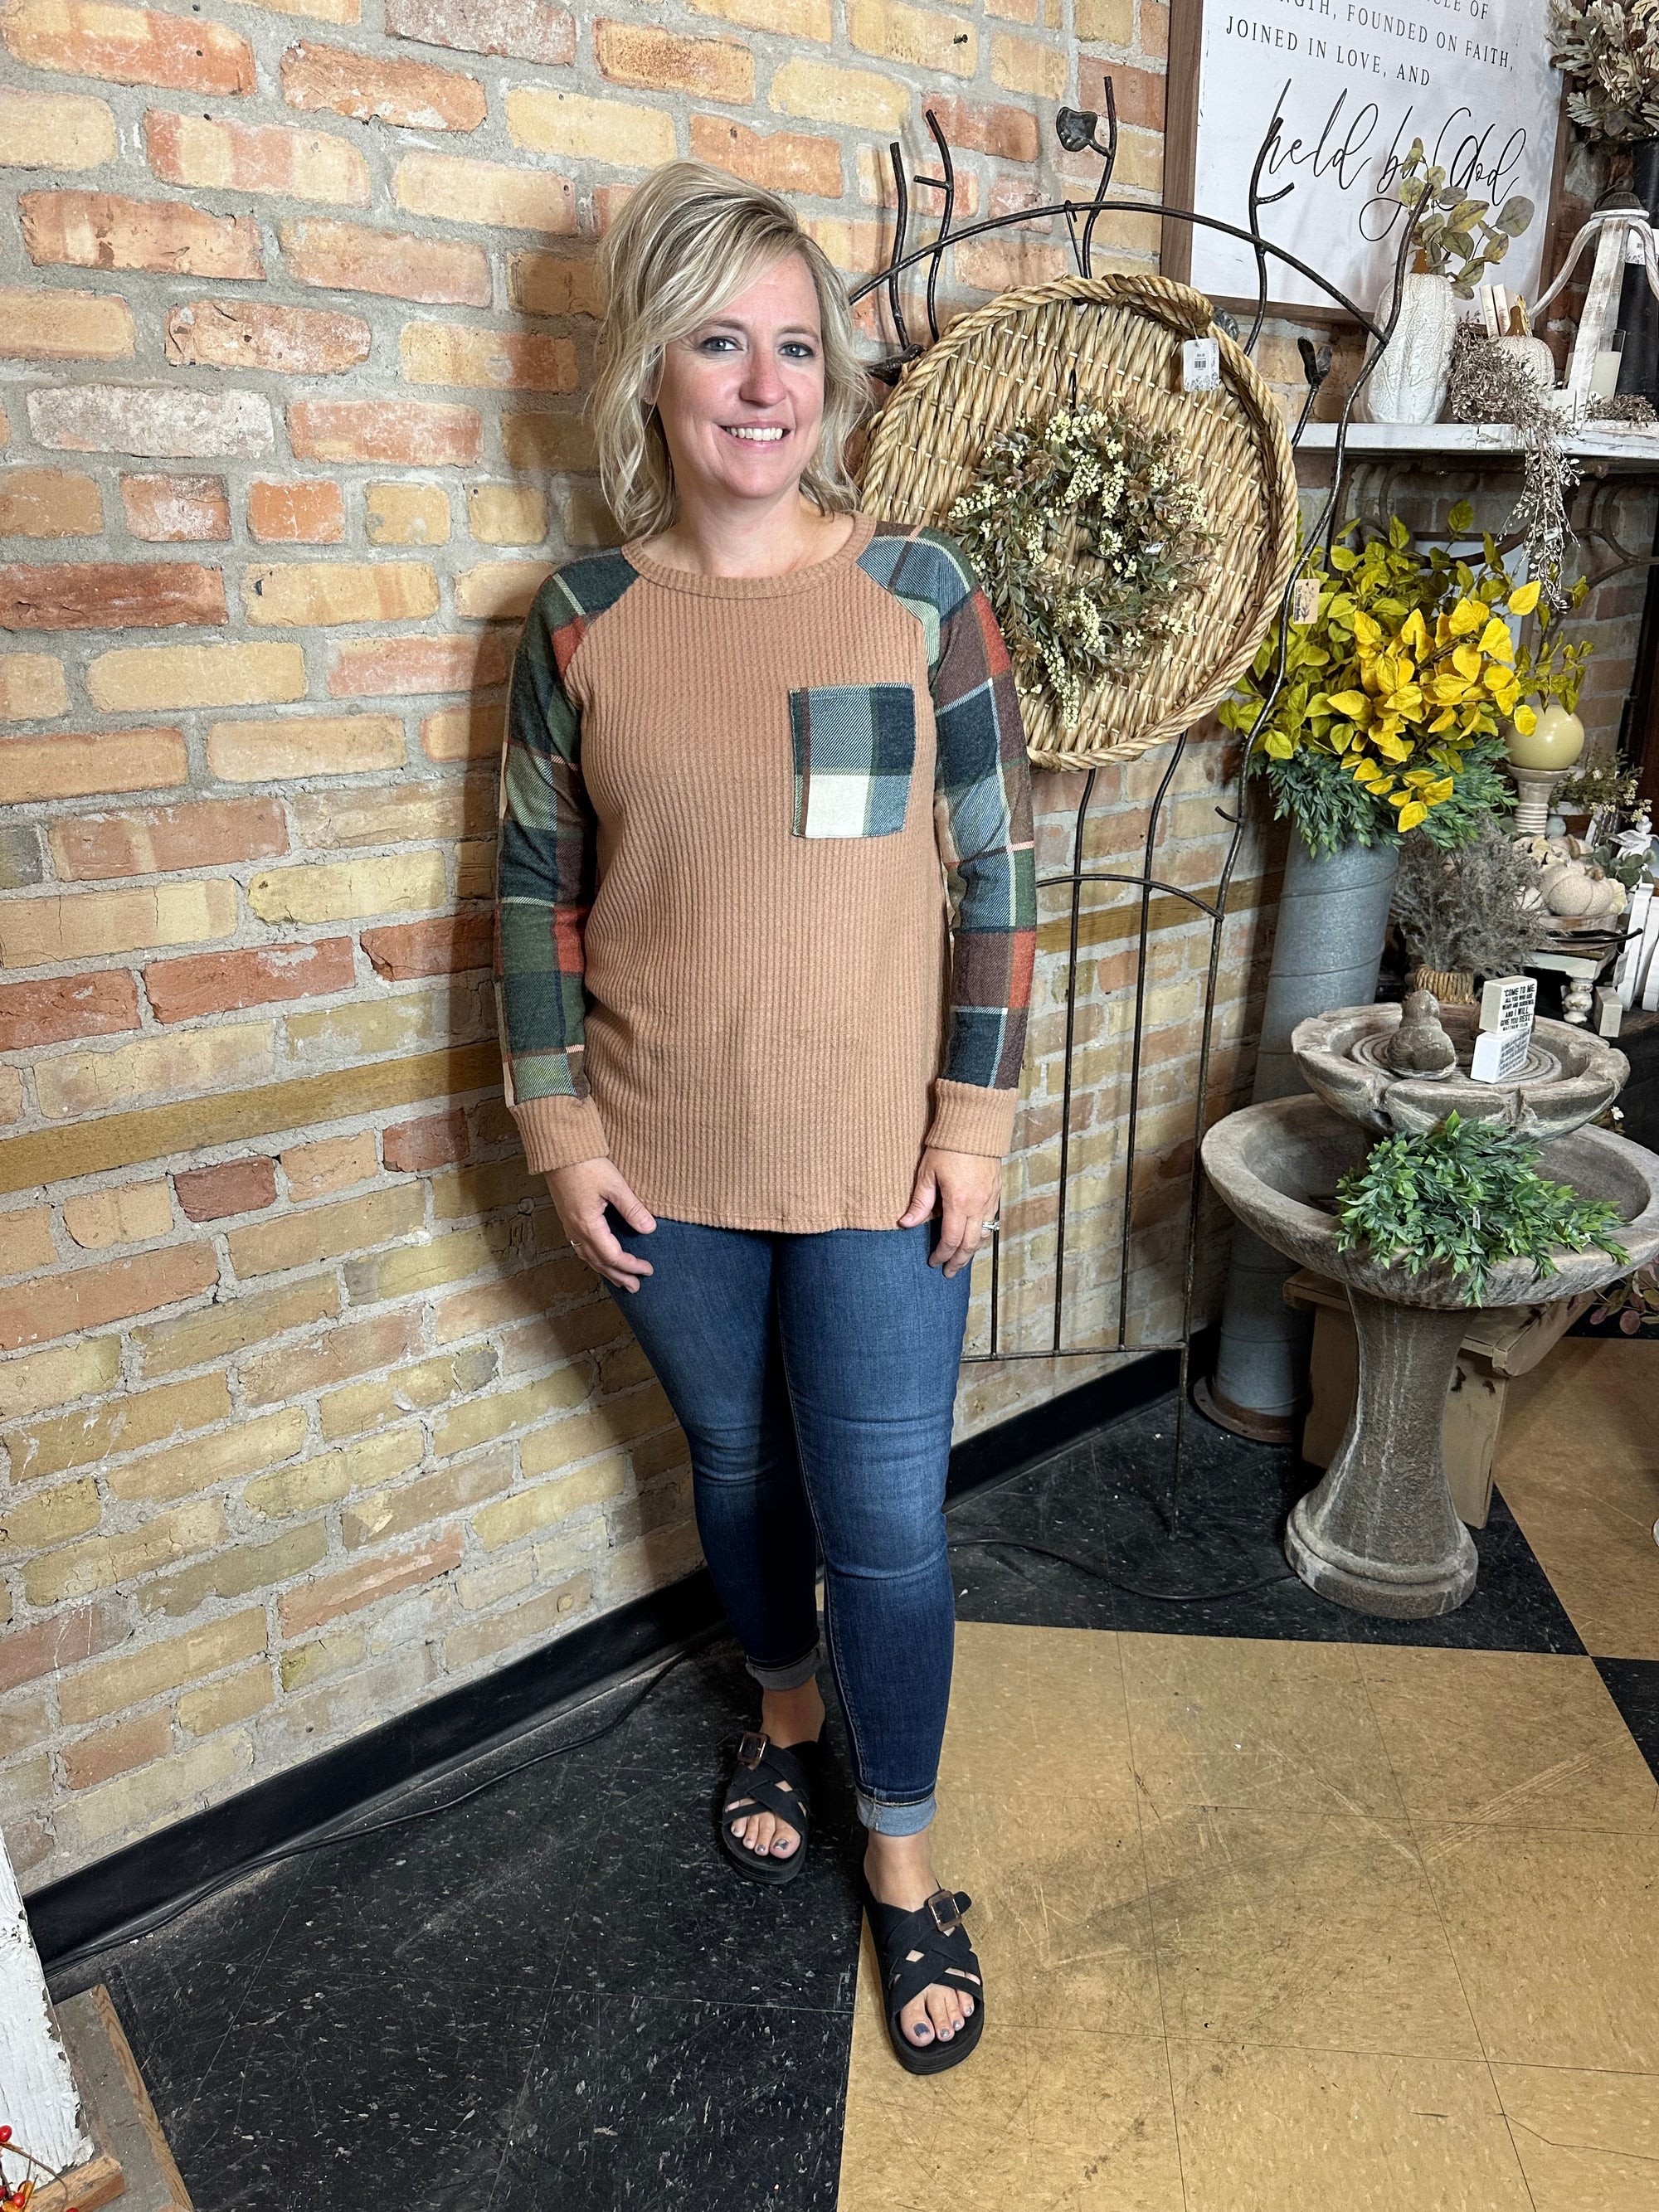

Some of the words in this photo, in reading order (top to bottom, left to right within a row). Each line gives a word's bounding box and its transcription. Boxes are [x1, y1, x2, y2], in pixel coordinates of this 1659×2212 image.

[1347, 4, 1428, 43] FOUNDED
[1436, 32, 1457, 52] ON
[1465, 40, 1513, 71] FAITH,
[1470, 0, 1488, 20] OF
[1226, 16, 1297, 51] JOINED
[1308, 37, 1326, 59] IN
[1336, 46, 1387, 78] LOVE,
[1396, 63, 1430, 86] AND
